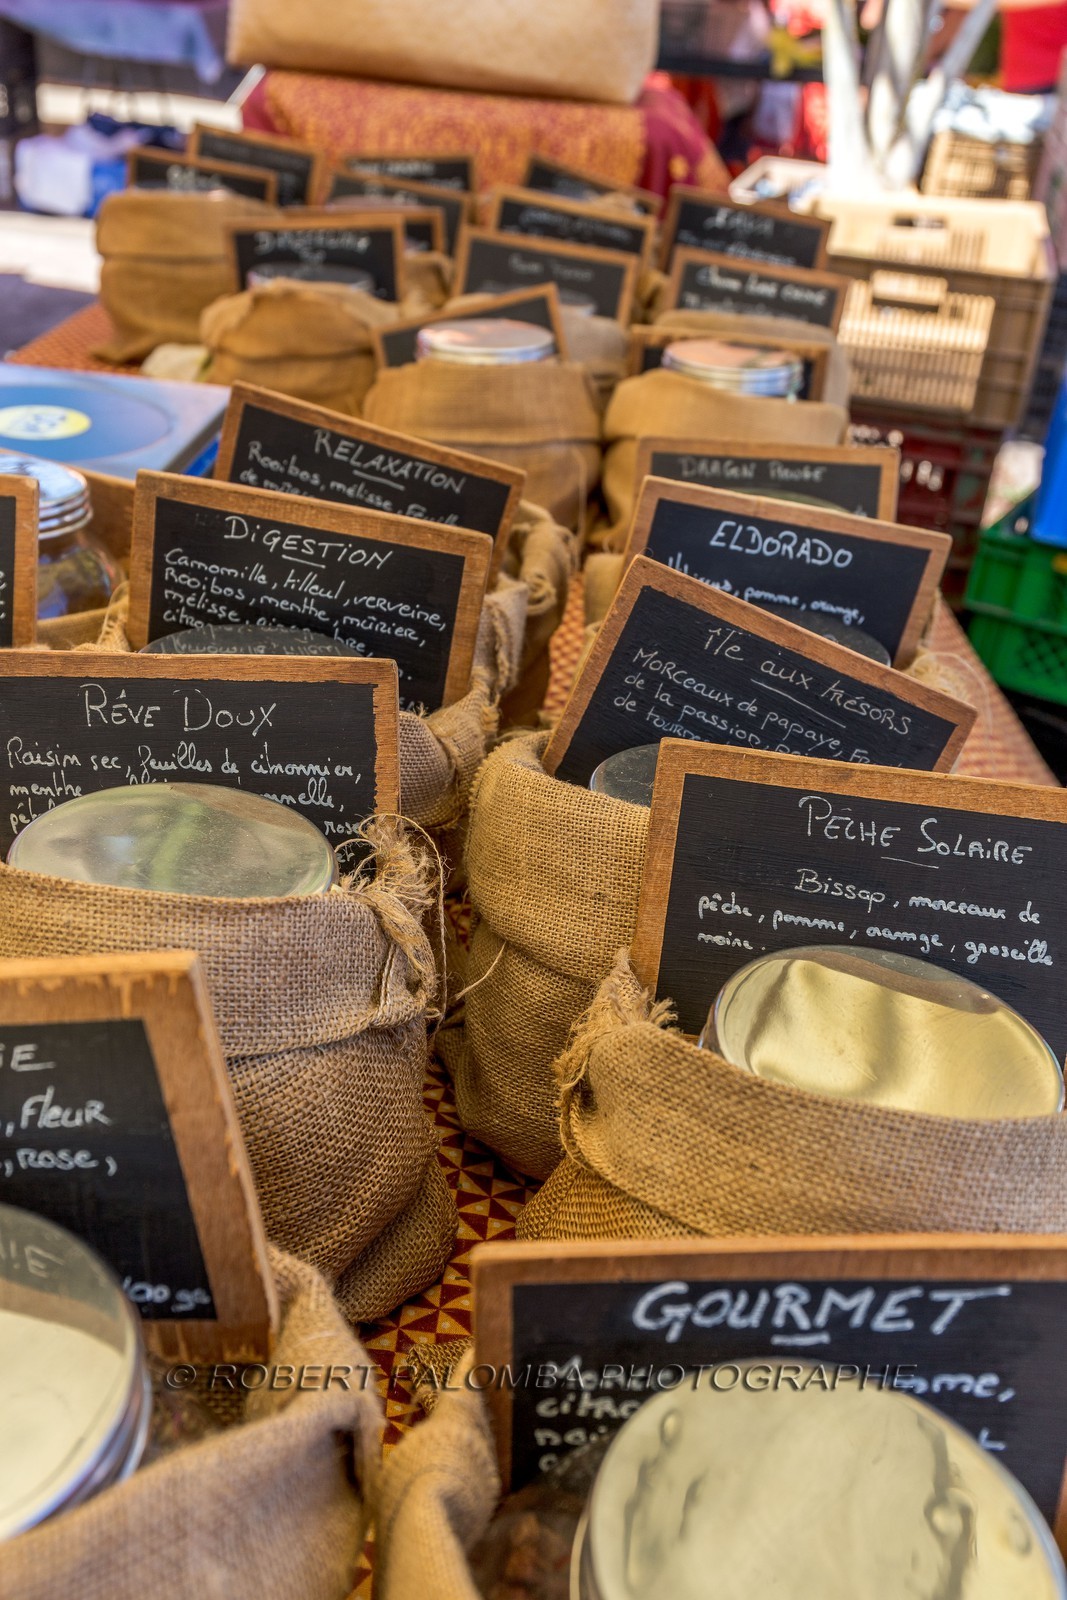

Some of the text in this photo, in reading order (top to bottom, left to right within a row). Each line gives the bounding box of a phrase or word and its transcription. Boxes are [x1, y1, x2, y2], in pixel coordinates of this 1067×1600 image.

[313, 428, 466, 494] RELAXATION
[239, 467, 259, 486] de
[709, 520, 853, 568] ELDORADO
[624, 672, 645, 690] de
[655, 682, 674, 706] la
[760, 660, 813, 691] aux
[614, 691, 637, 712] de
[737, 697, 758, 717] de
[221, 748, 240, 774] de
[1019, 901, 1041, 925] de
[632, 1281, 1012, 1343] GOURMET
